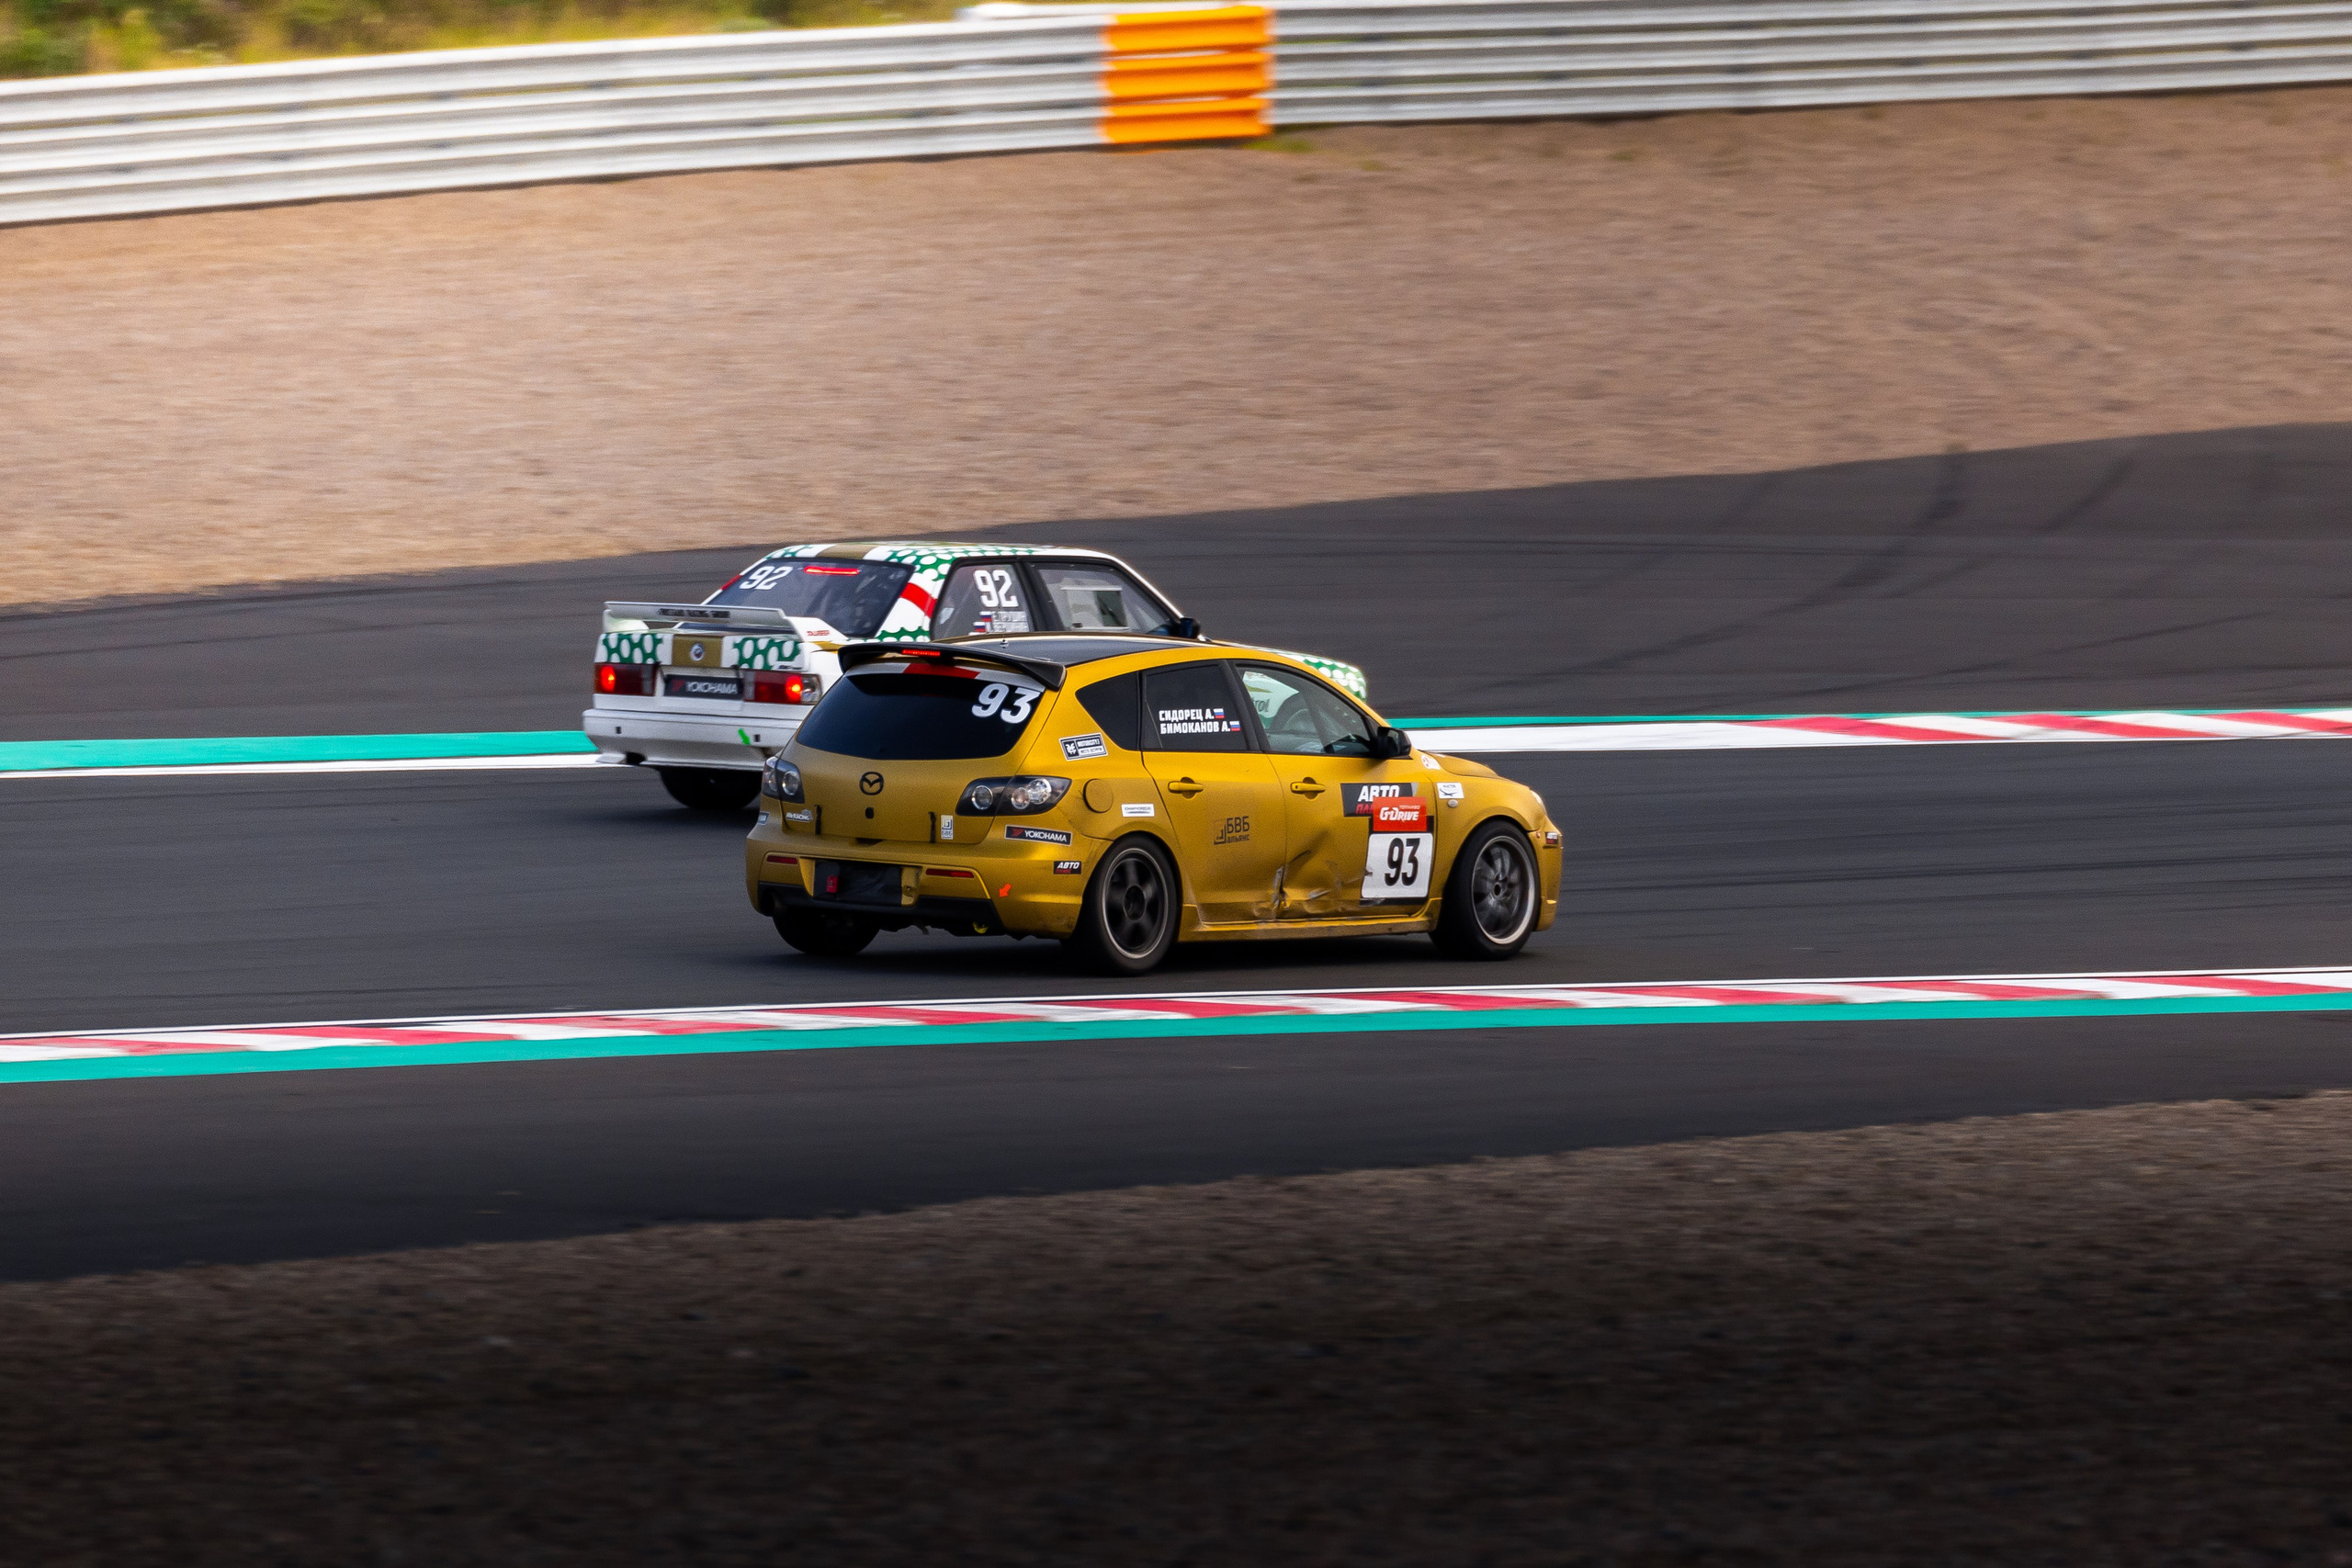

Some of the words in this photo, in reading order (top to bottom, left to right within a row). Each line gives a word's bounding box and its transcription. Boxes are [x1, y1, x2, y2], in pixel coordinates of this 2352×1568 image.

[739, 566, 794, 590] 92
[974, 570, 1019, 607] 92
[971, 683, 1041, 724] 93
[1159, 708, 1204, 722] СИДОРЕЦ
[1204, 708, 1215, 719] А.
[1159, 722, 1220, 735] БИМОКАНОВ
[1221, 721, 1231, 732] А.
[1023, 829, 1068, 842] YOKOHAMA
[1385, 838, 1420, 886] 93
